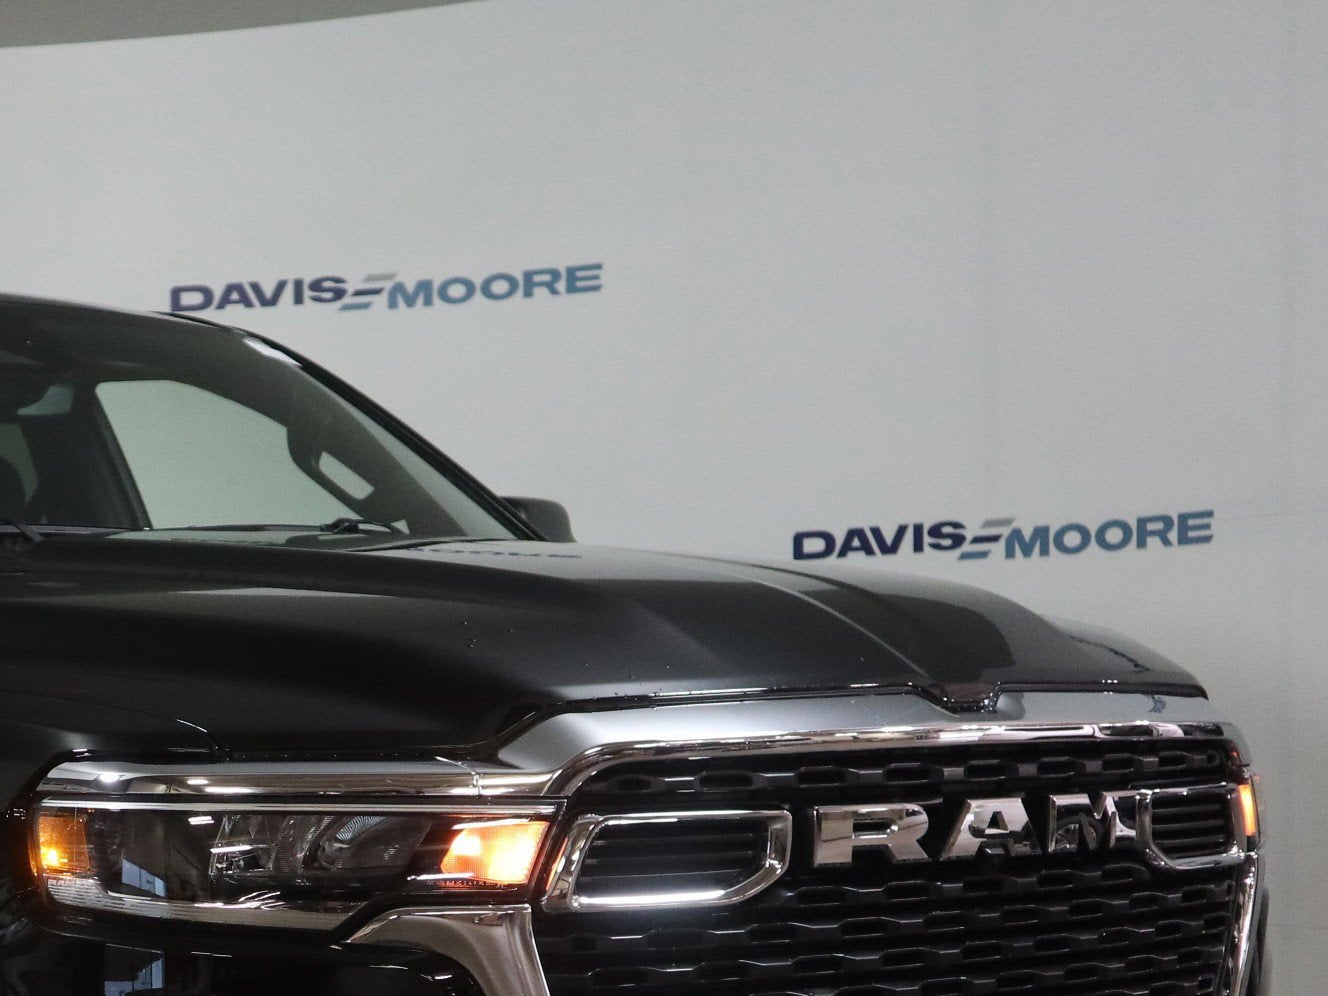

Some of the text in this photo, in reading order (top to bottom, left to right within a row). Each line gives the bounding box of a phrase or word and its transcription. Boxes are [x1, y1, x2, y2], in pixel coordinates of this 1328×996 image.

[169, 263, 604, 314] DAVIS MOORE
[791, 509, 1215, 561] DAVIS MOORE
[813, 792, 1138, 867] RAM
